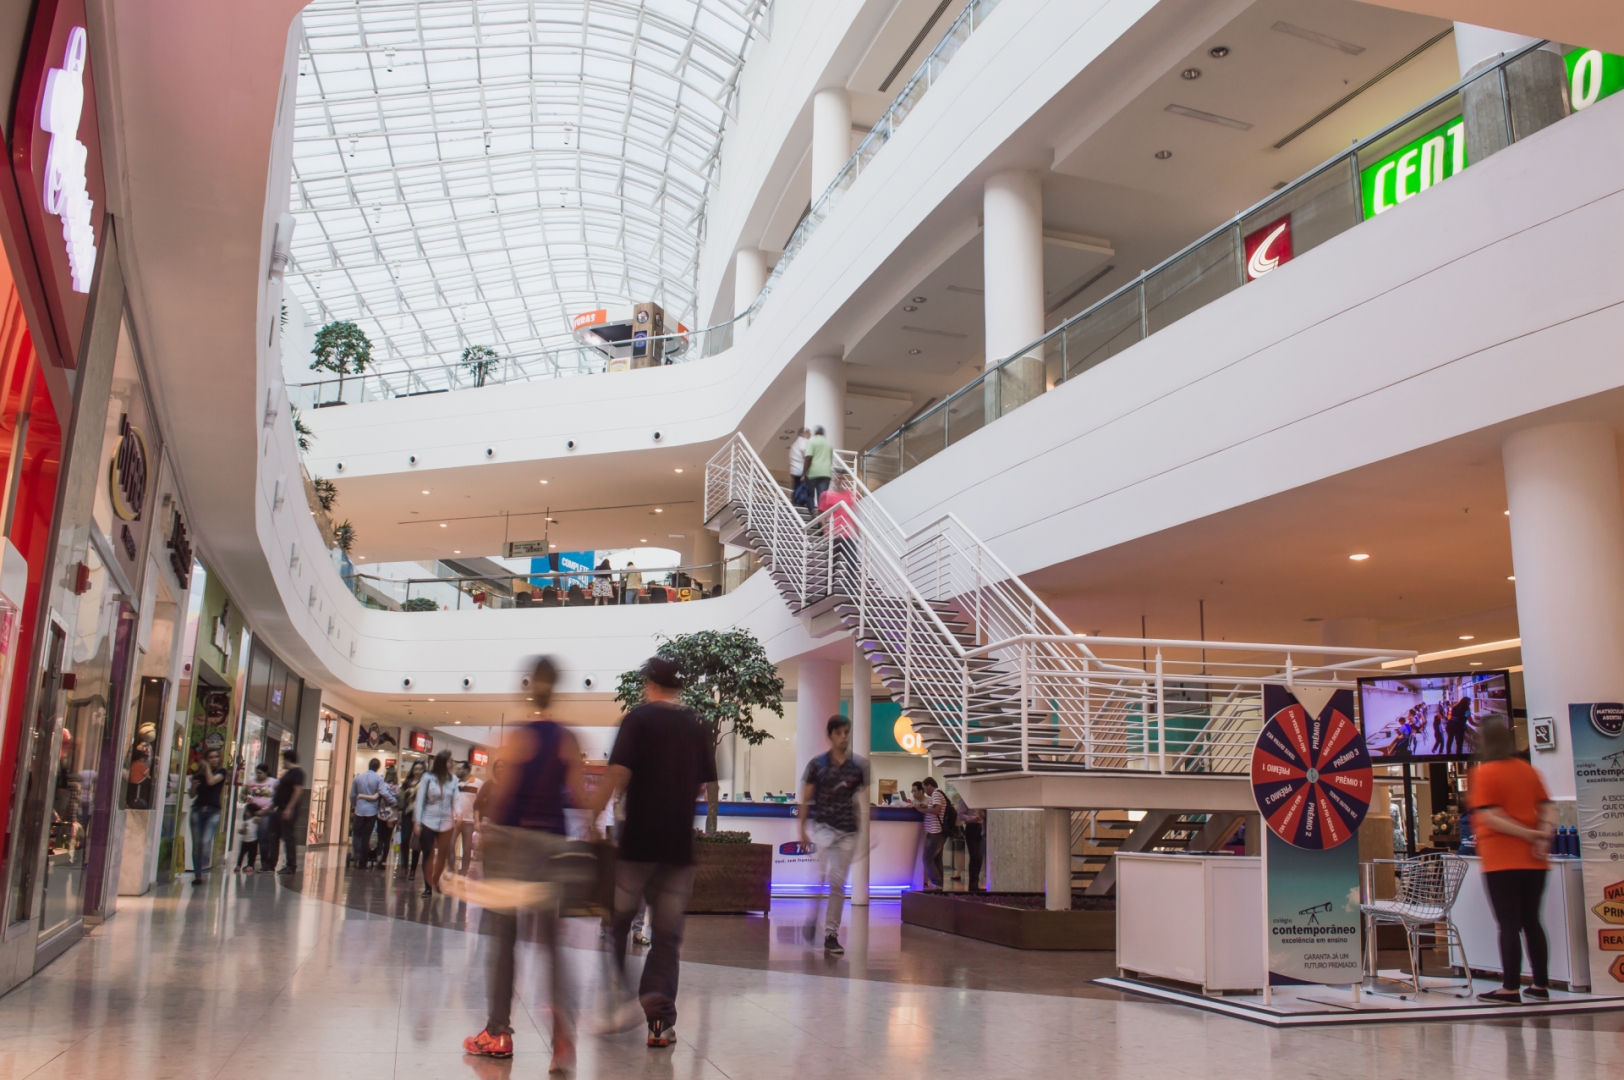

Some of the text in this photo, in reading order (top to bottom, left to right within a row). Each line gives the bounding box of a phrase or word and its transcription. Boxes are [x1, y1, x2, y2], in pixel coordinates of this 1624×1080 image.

[1311, 721, 1320, 750] PRÊMIO
[1333, 748, 1360, 768] PRÊMIO 3
[1266, 764, 1291, 776] PRÊMIO
[1335, 775, 1363, 788] PRÊMIO 1
[1264, 783, 1293, 805] PRÊMIO 3
[1305, 802, 1315, 831] PRÊMIO
[1272, 924, 1356, 937] contemporâneo
[1331, 952, 1339, 960] JÁ
